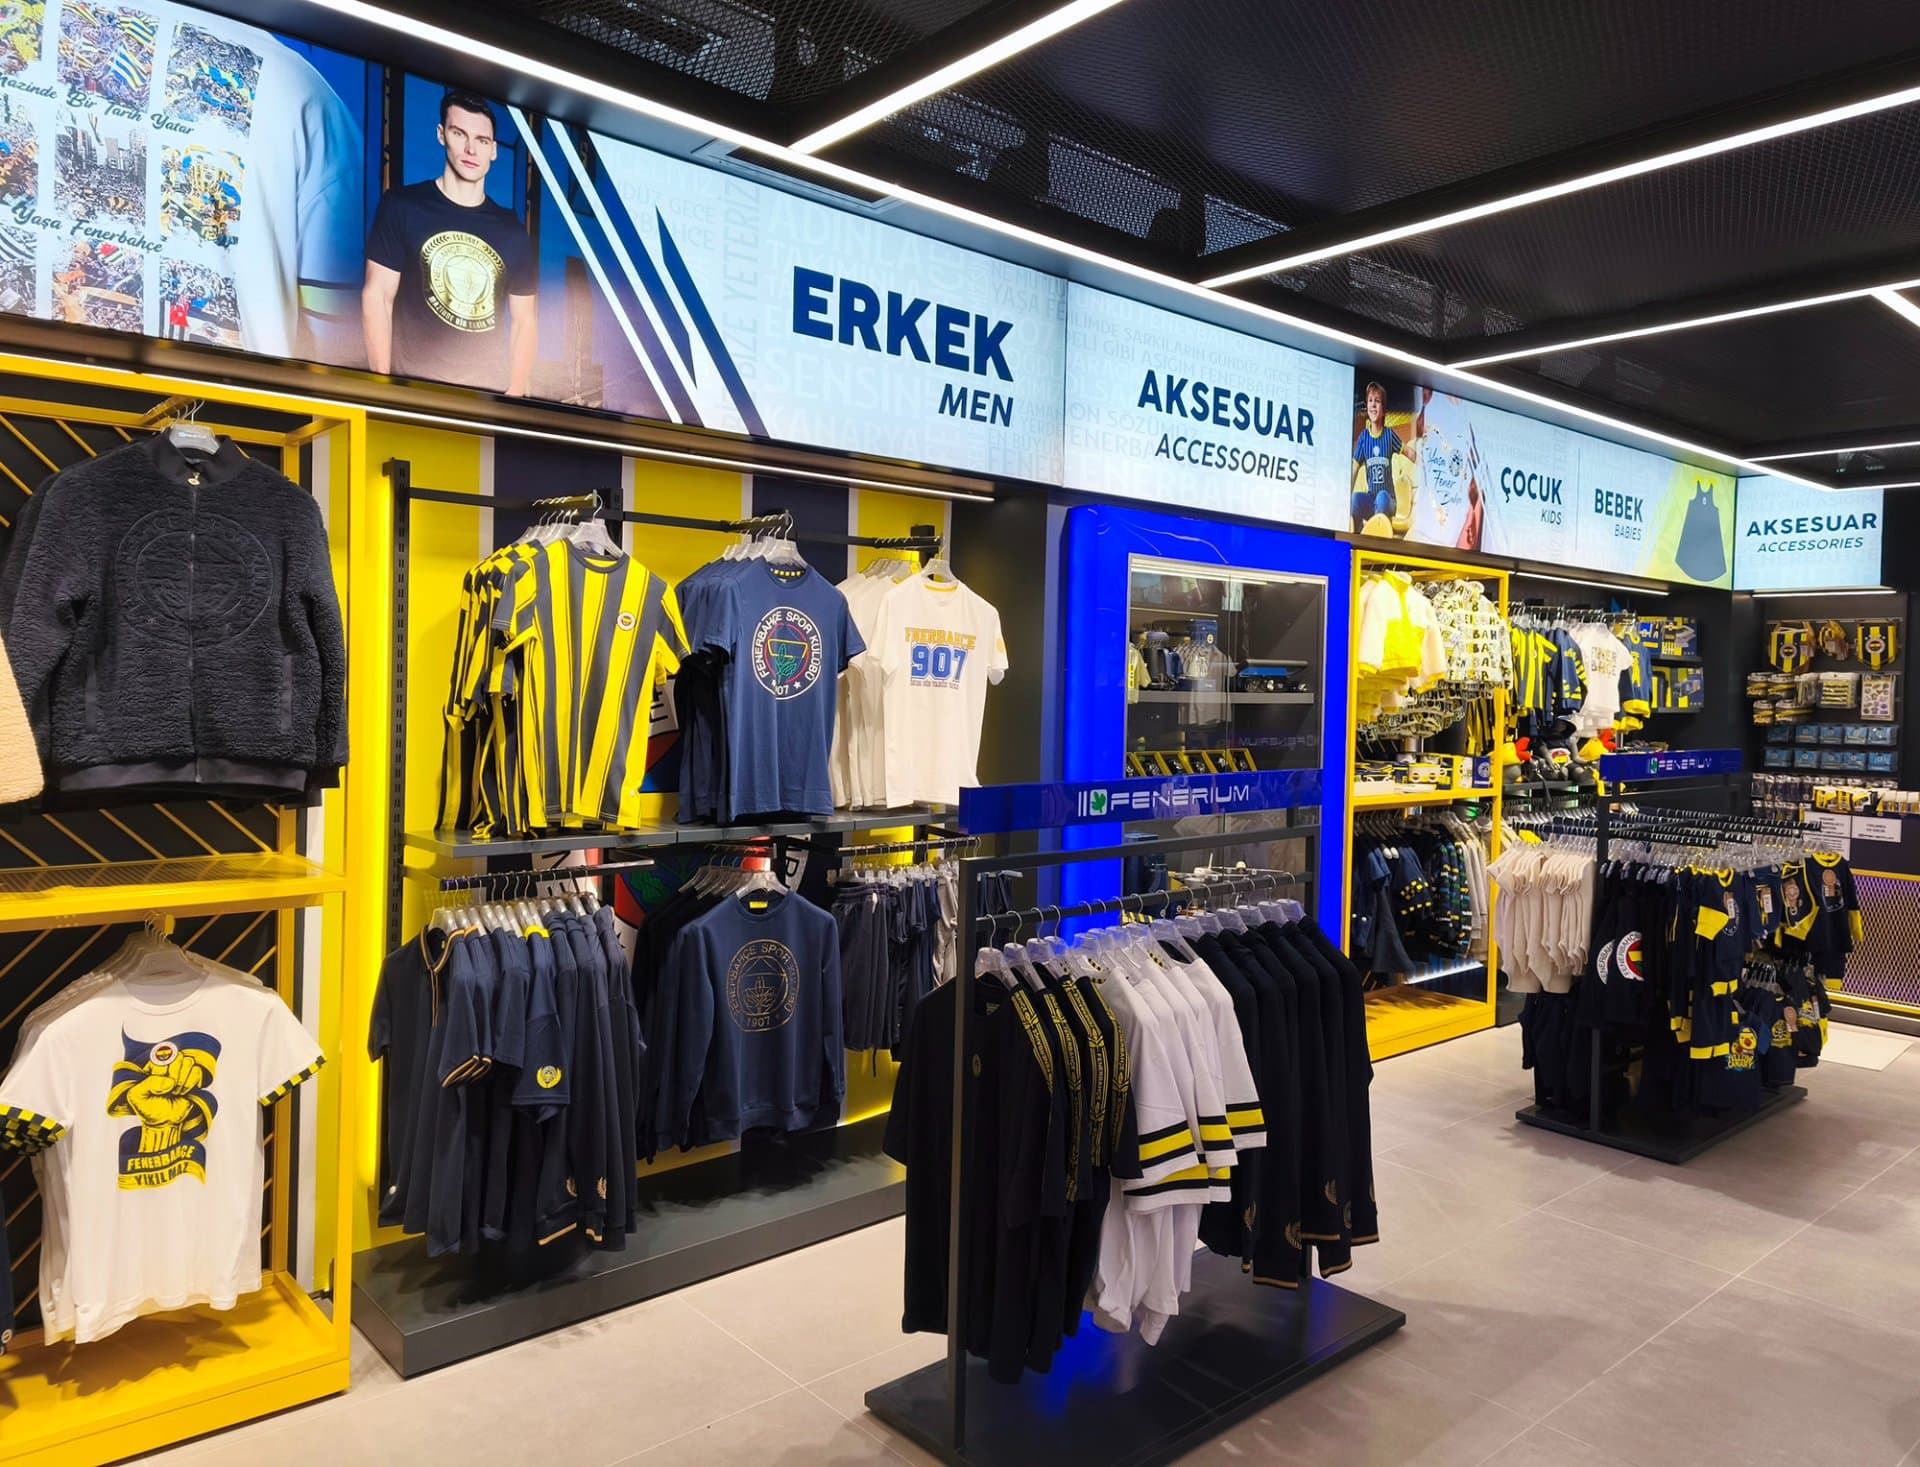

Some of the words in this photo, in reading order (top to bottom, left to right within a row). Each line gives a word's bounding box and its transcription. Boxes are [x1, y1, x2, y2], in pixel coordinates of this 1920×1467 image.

[66, 88, 95, 109] Bir
[150, 112, 195, 135] Yatar
[69, 217, 163, 253] Fenerbahçe
[793, 265, 1014, 383] ERKEK
[938, 383, 1014, 428] MEN
[1137, 369, 1315, 446] AKSESUAR
[1155, 433, 1300, 484] ACCESSORIES
[1500, 467, 1563, 506] ÇOCUK
[1541, 511, 1562, 526] KIDS
[1594, 488, 1644, 523] BEBEK
[1614, 524, 1642, 542] BABIES
[1746, 512, 1878, 538] AKSESUAR
[1757, 537, 1864, 553] ACCESSORIES
[785, 611, 812, 635] SPOR
[1111, 784, 1250, 811] FENERIUM
